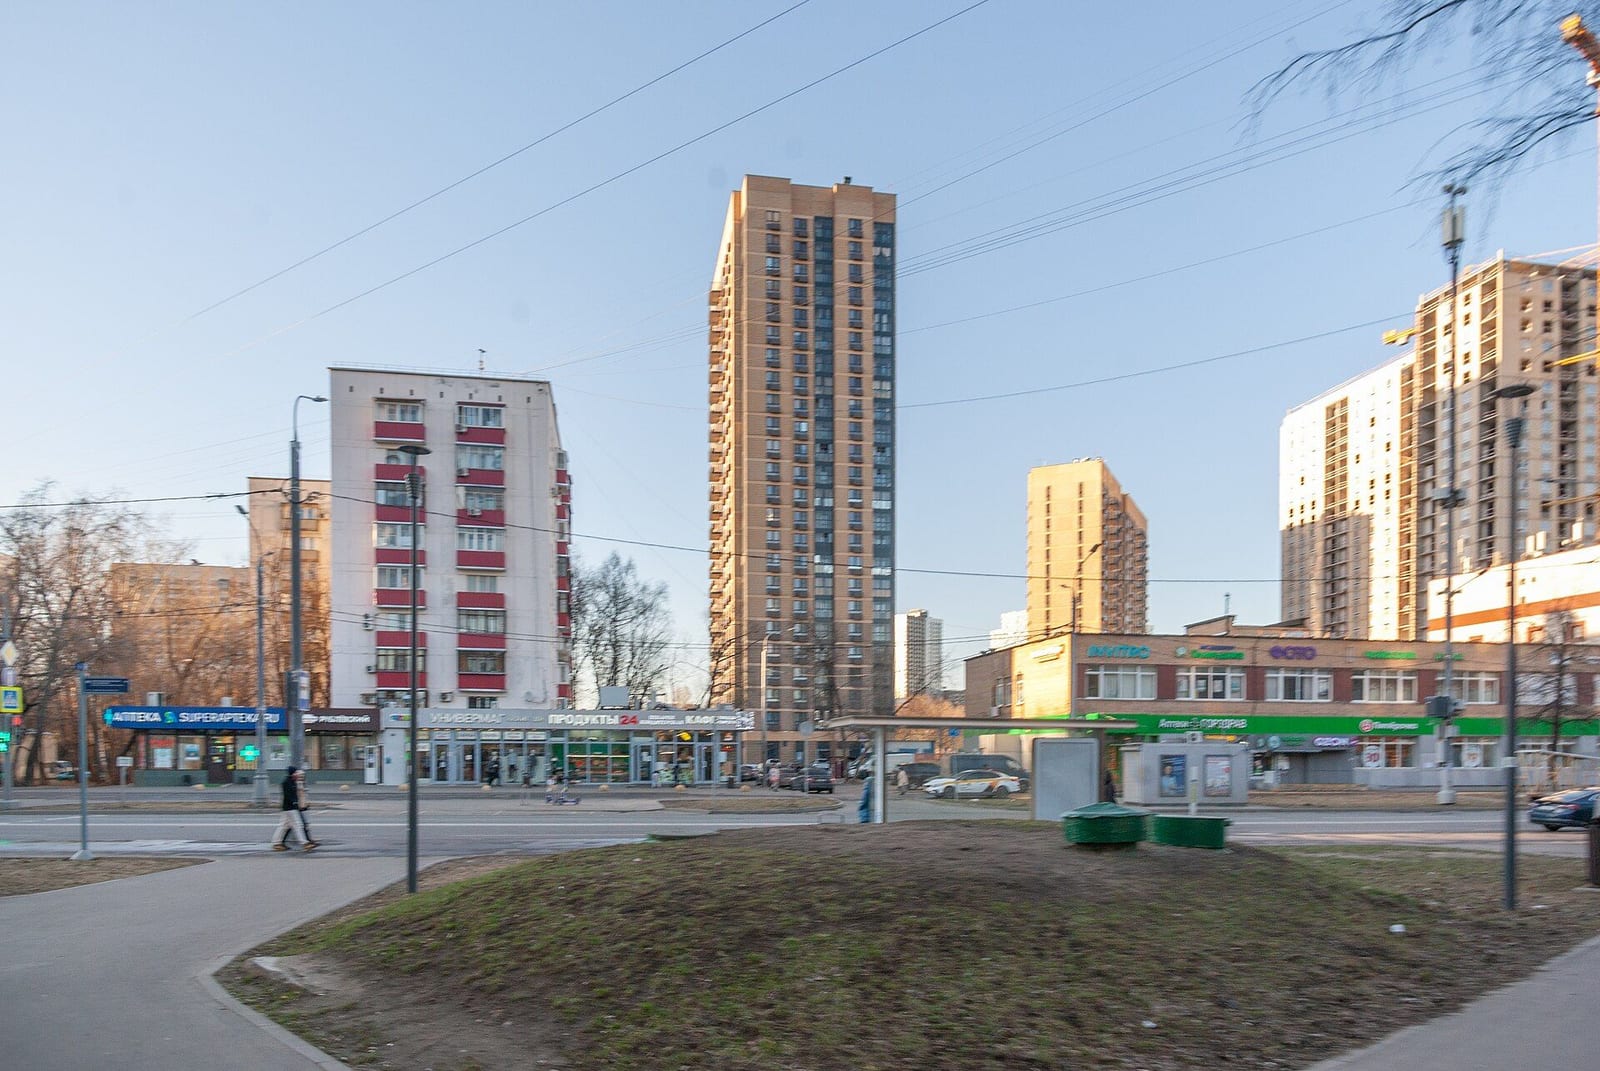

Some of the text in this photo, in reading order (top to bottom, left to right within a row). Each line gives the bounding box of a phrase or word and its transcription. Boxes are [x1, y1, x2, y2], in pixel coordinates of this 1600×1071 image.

[113, 712, 161, 722] АПТЕКА
[179, 713, 280, 723] SUPERAPTEKARU
[430, 713, 505, 724] УНИВЕРМАГ
[548, 714, 619, 726] ПРОДУКТЫ
[620, 715, 639, 725] 24
